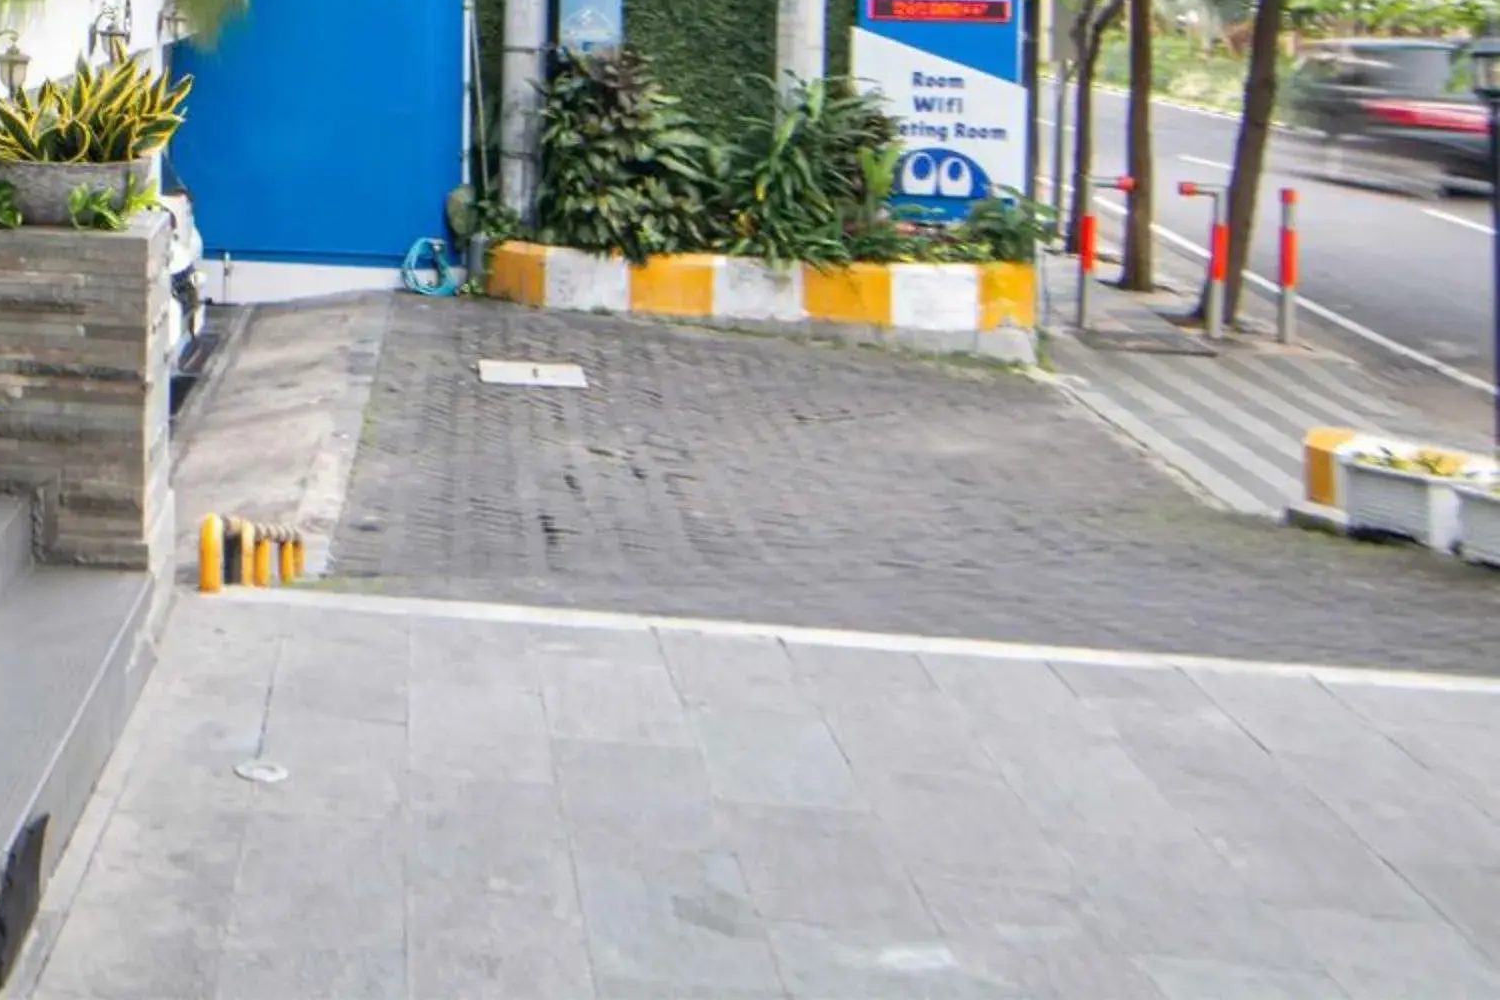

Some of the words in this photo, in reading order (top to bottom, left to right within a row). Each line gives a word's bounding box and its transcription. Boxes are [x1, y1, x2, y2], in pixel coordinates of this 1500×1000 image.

[912, 71, 965, 88] Room
[899, 121, 948, 141] eting
[954, 122, 1007, 140] Room
